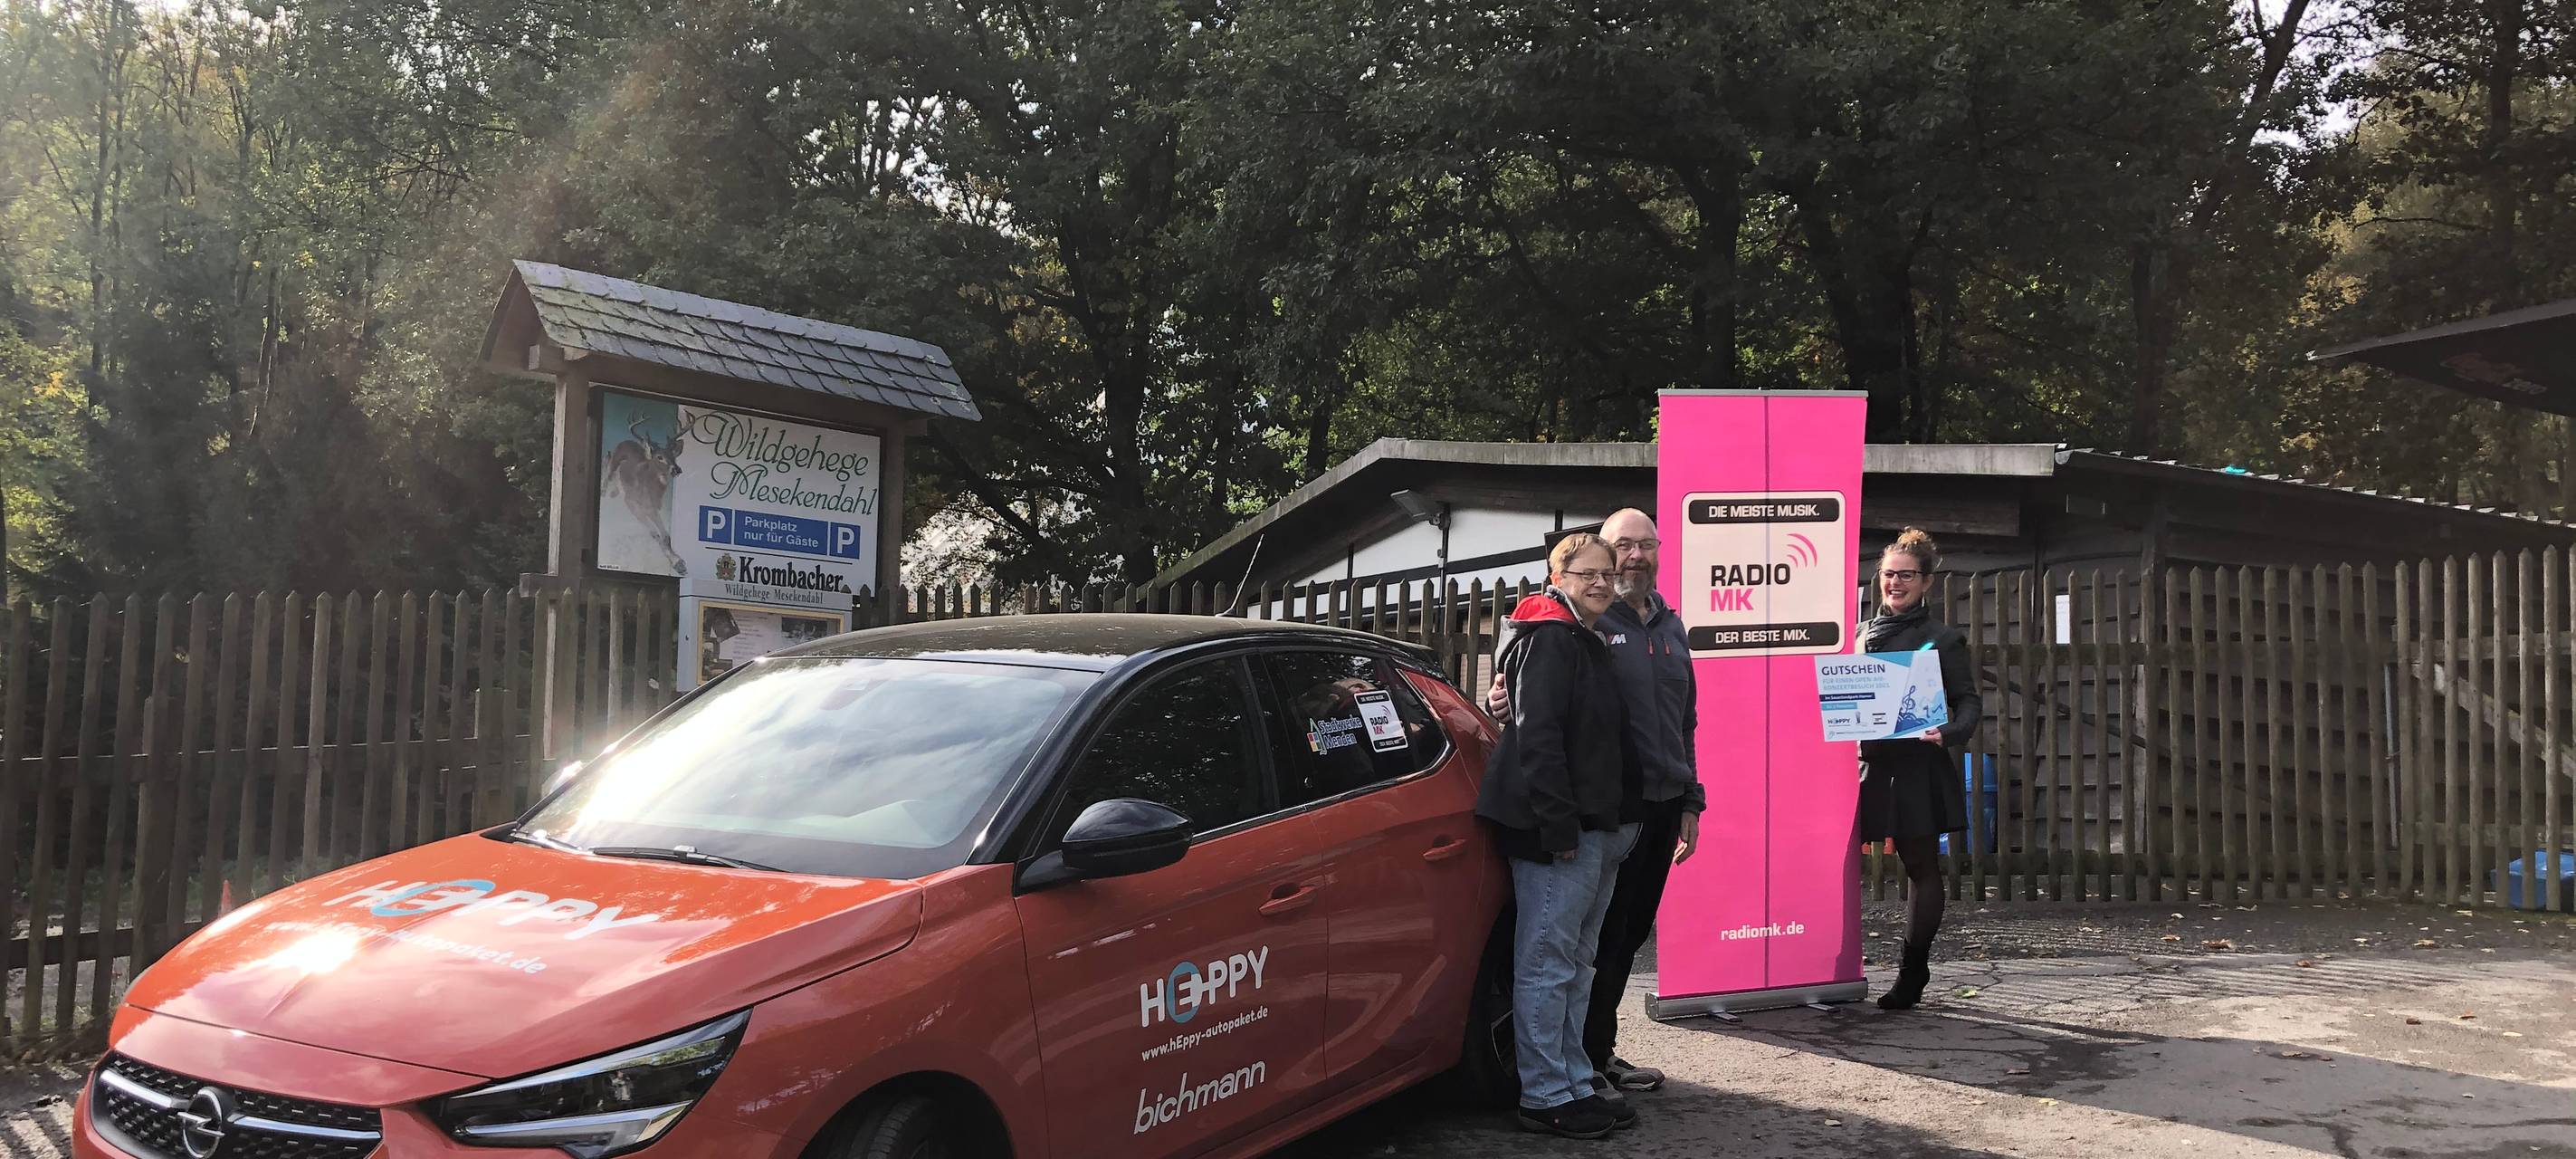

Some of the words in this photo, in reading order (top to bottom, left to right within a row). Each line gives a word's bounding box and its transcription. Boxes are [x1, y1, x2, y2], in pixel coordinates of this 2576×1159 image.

[691, 410, 869, 481] Wildgehege
[710, 461, 878, 515] Mesekendahl
[1709, 505, 1727, 518] DIE
[1730, 504, 1775, 518] MEISTE
[1777, 503, 1820, 517] MUSIK.
[706, 510, 726, 539] P
[744, 516, 797, 532] Parkplatz
[744, 532, 763, 541] nur
[767, 532, 783, 543] für
[786, 534, 819, 548] Gäste
[837, 526, 854, 554] P
[739, 556, 844, 593] Krombacher
[1711, 562, 1791, 587] RADIO
[724, 583, 770, 599] Wildgehege
[774, 589, 824, 605] Mesekendahl
[1710, 588, 1754, 612] MK
[1715, 631, 1740, 644] DER
[1742, 629, 1780, 643] BESTE
[1783, 628, 1810, 641] MIX.
[1821, 664, 1886, 675] GUTSCHEIN
[1318, 714, 1363, 734] Stadtwerke
[1369, 715, 1389, 726] RADIO
[1323, 732, 1358, 749] Menden
[1721, 920, 1805, 941] radiomk.de
[1141, 1005, 1268, 1061] www.hEppy-autopaket.de
[1133, 1060, 1266, 1135] bichmann
